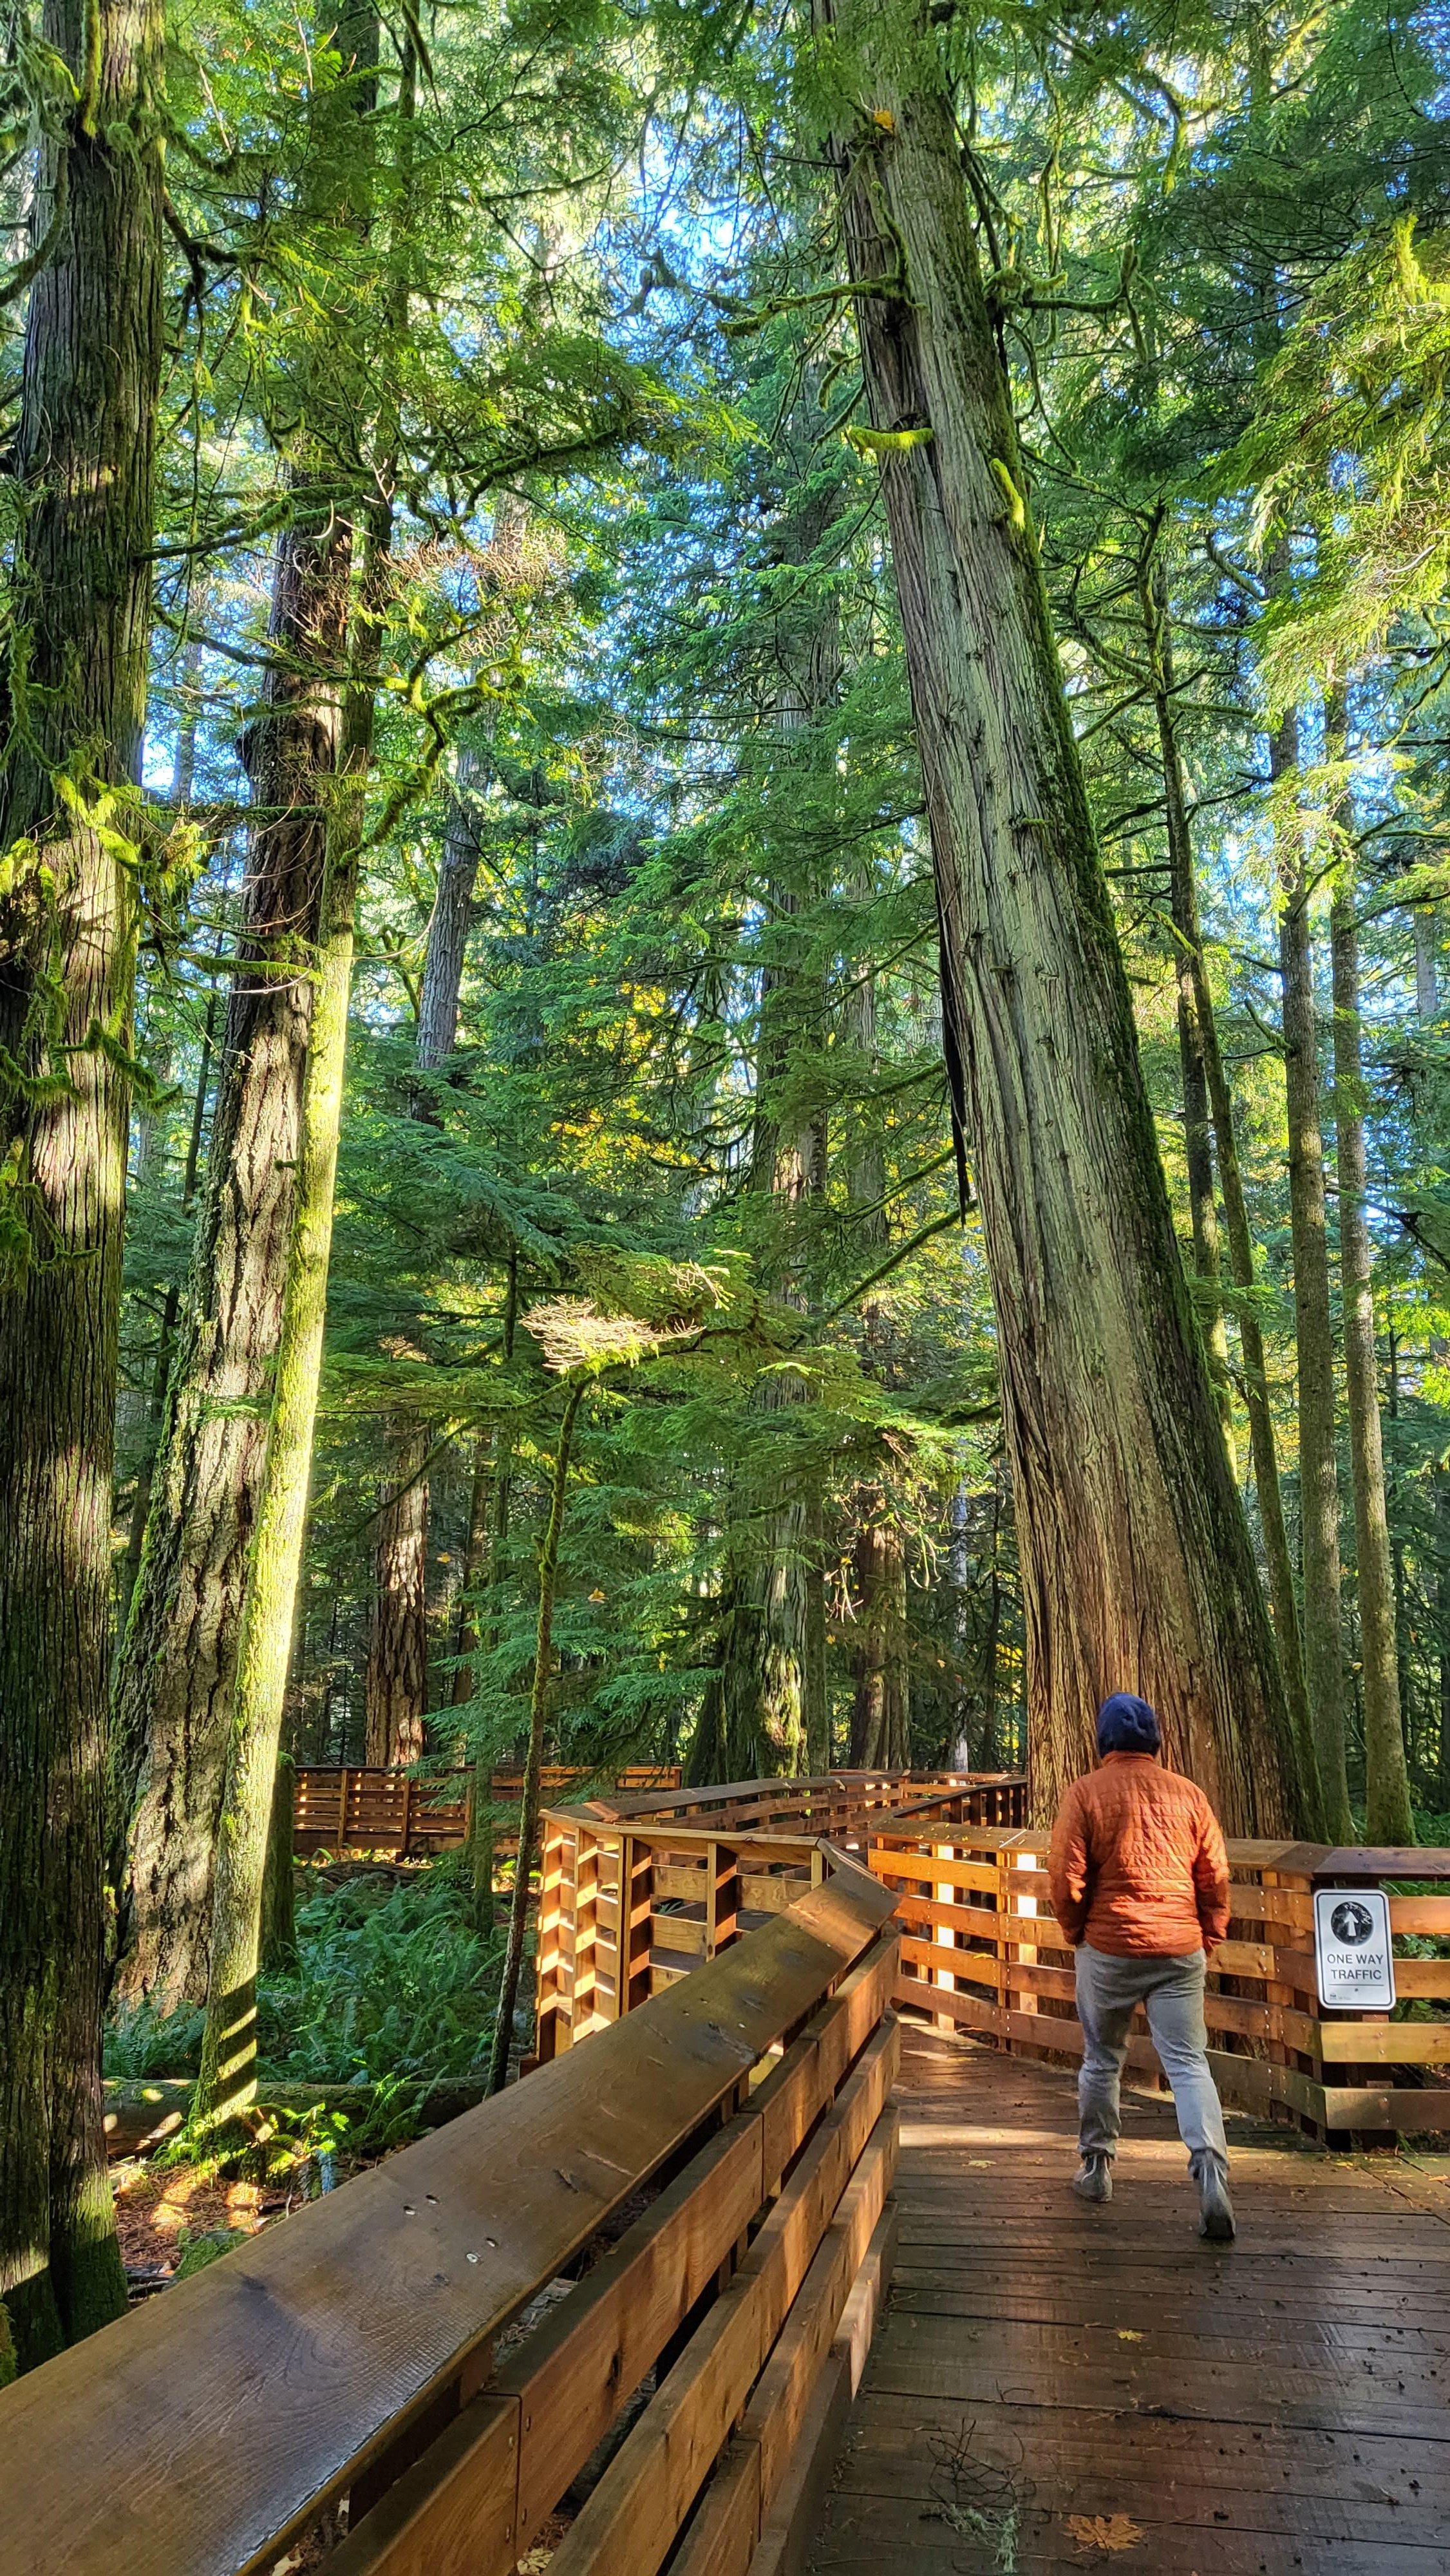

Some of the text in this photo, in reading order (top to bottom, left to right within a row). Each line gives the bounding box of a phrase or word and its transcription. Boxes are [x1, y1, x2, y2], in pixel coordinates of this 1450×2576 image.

[1327, 1953, 1384, 1965] ONE WAY
[1331, 1969, 1382, 1980] TRAFFIC
